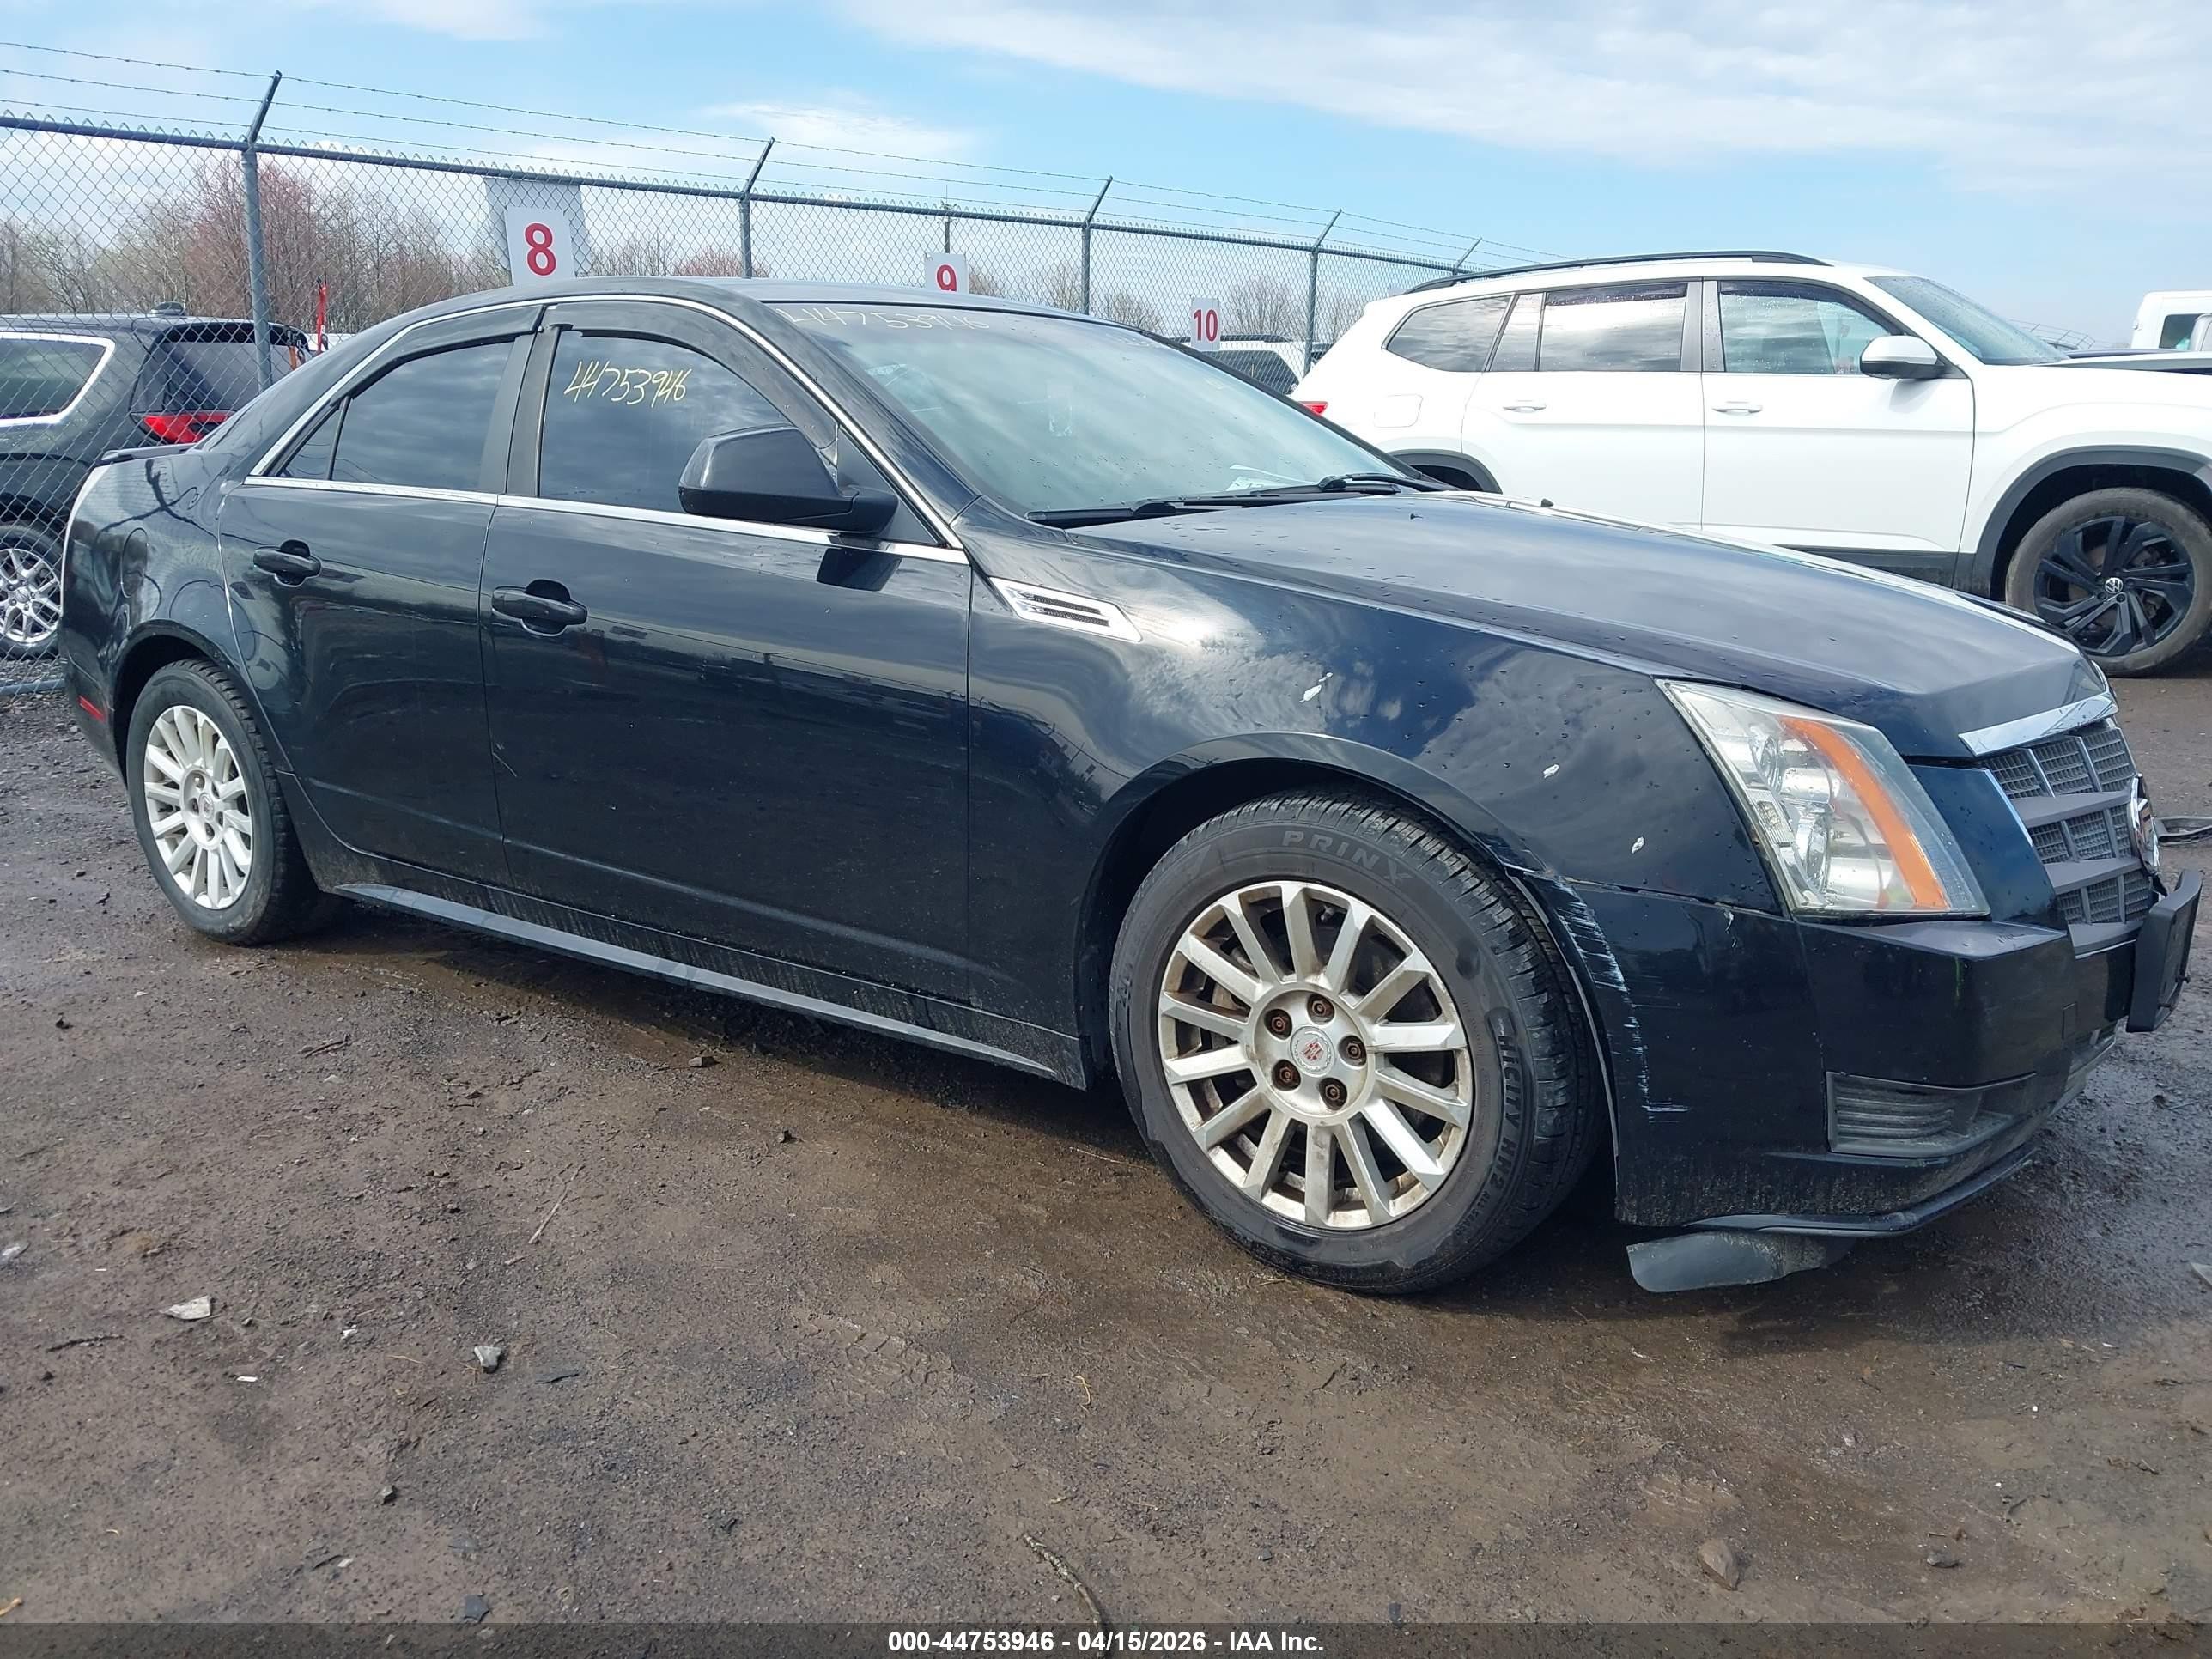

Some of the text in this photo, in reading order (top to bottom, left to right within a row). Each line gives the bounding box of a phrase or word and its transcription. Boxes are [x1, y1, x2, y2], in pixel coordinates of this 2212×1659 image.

[524, 222, 556, 276] 8
[776, 307, 990, 330] 44753946
[1193, 308, 1218, 342] 10
[563, 360, 692, 408] 44753946
[1282, 830, 1413, 884] PRINX
